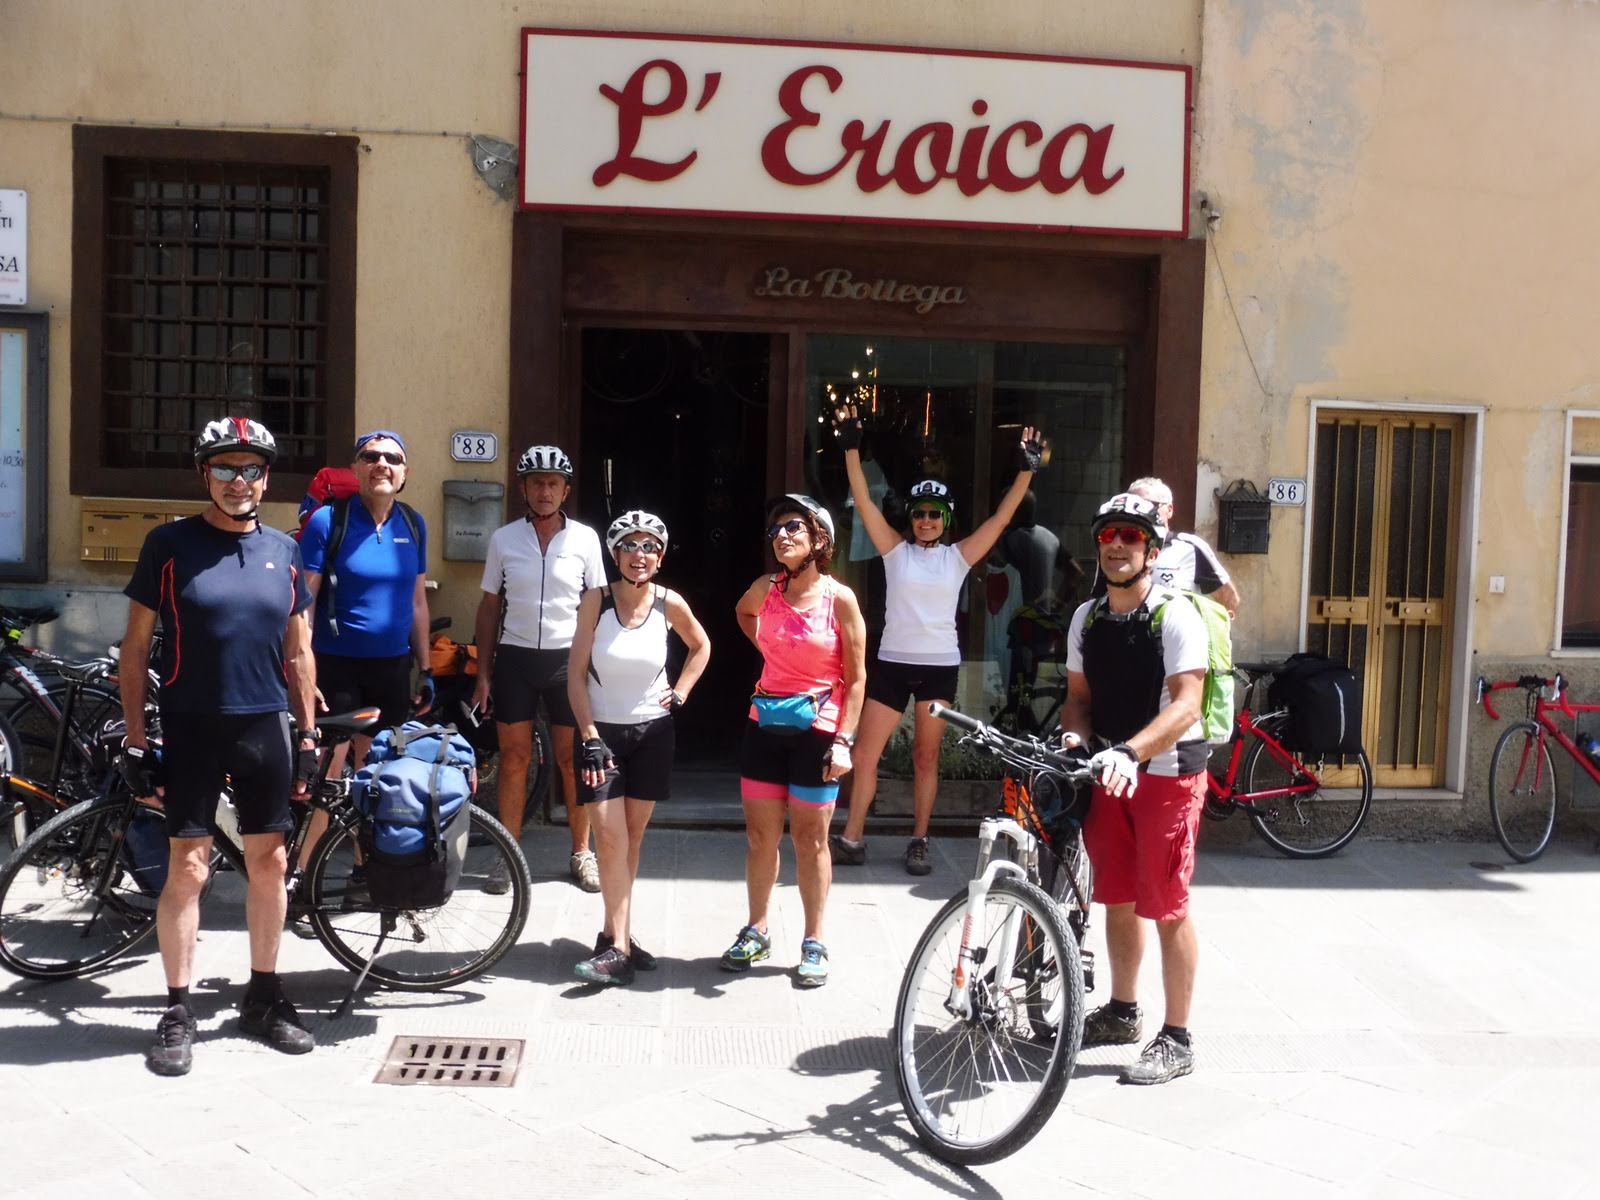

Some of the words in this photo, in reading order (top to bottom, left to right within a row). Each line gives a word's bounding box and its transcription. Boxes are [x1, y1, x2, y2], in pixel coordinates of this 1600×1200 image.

[592, 58, 722, 187] L'
[760, 64, 1125, 197] Eroica
[755, 266, 812, 296] La
[814, 268, 968, 314] Bottega
[462, 437, 486, 456] 88
[1276, 484, 1297, 501] 86
